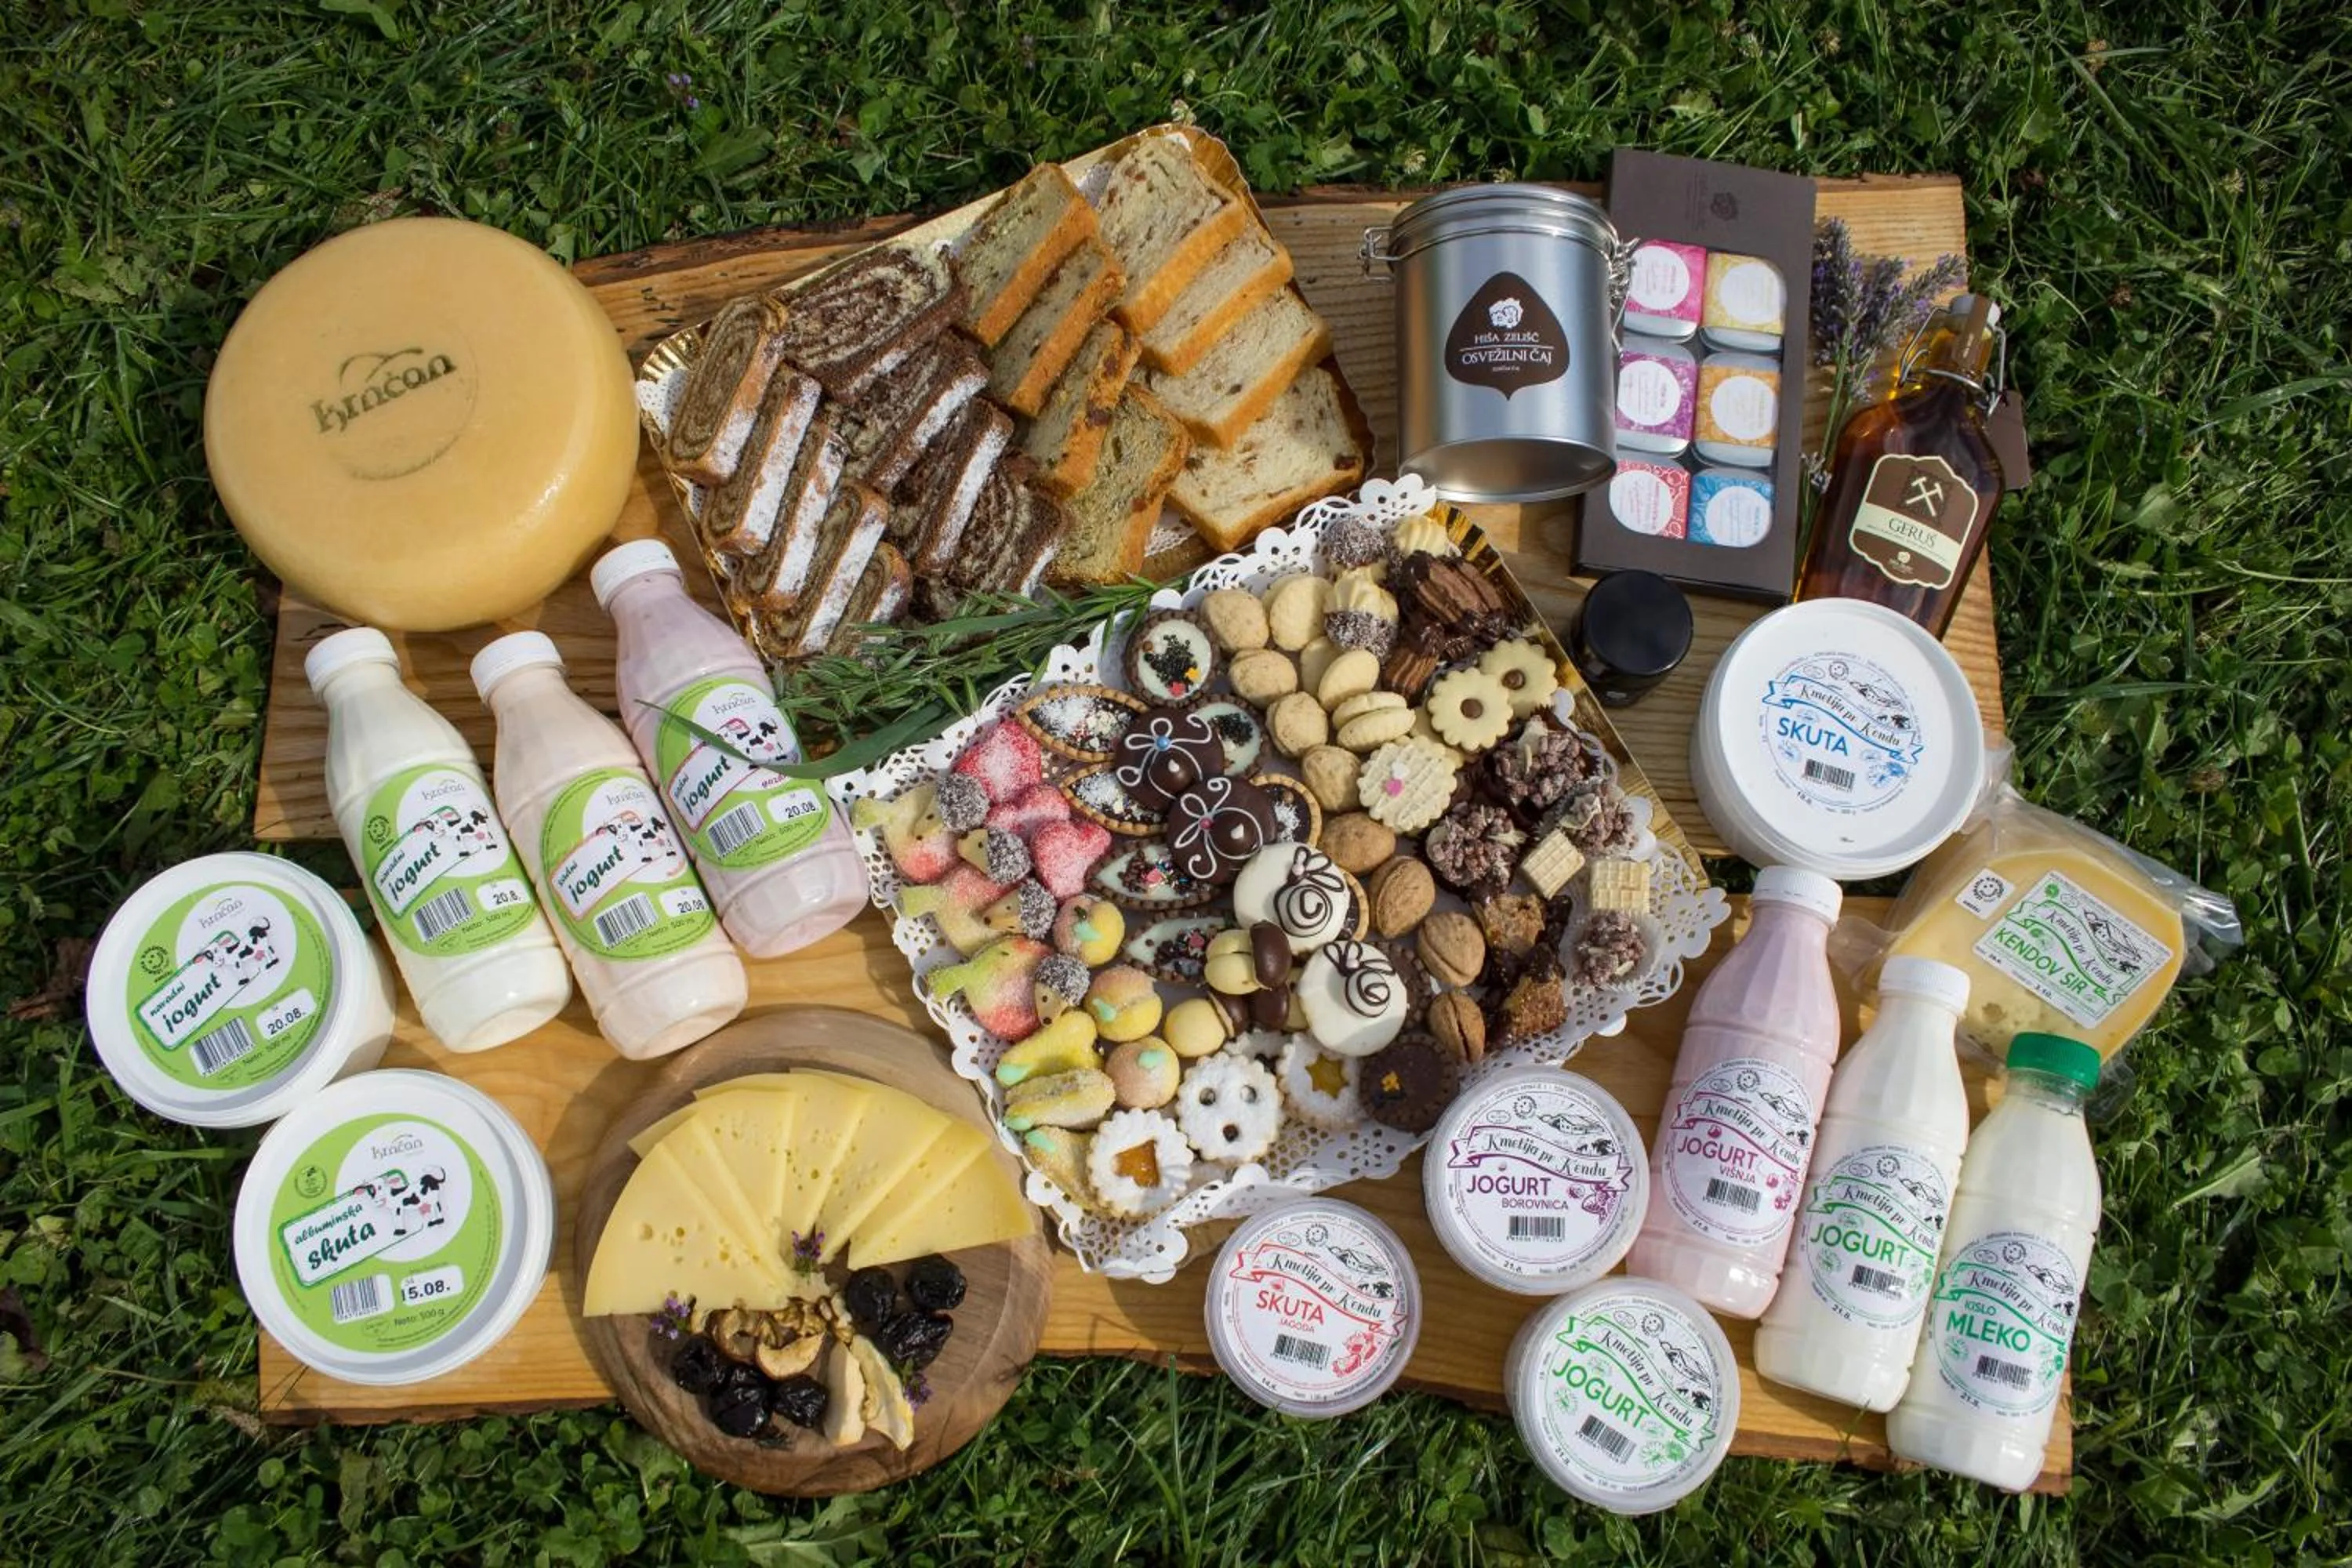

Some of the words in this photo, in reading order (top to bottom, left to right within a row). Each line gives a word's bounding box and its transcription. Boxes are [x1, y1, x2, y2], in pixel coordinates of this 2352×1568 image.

[1461, 348, 1527, 365] OSVEŽILNI
[1529, 348, 1552, 365] ČAJ
[1474, 332, 1500, 343] HIŠA
[1888, 517, 1937, 548] GERUS
[1776, 717, 1849, 757] SKUTA
[682, 753, 732, 816] jogurt
[386, 840, 441, 902] jogurt
[568, 844, 625, 904] jogurt
[1993, 927, 2063, 977] KENDOV
[2060, 971, 2089, 996] SIR
[162, 971, 222, 1034] jogurt
[1486, 1133, 1539, 1157] Kmetija
[1555, 1156, 1607, 1178] Kendu
[1677, 1136, 1759, 1171] JOGURT
[1719, 1164, 1757, 1185] VIŠNJA
[1465, 1174, 1552, 1197] JOGURT
[1501, 1196, 1569, 1210] BOROVNICA
[293, 1203, 364, 1246] albuminska
[306, 1221, 377, 1271] skuta
[1809, 1221, 1910, 1268] JOGURT
[1255, 1289, 1325, 1326] SKUTA
[1265, 1253, 1323, 1285] Kmetija
[1336, 1291, 1382, 1319] Kendu
[1964, 1298, 1997, 1317] KISLO
[1945, 1310, 2031, 1353] MLEKO
[1552, 1358, 1651, 1429] JOGURT
